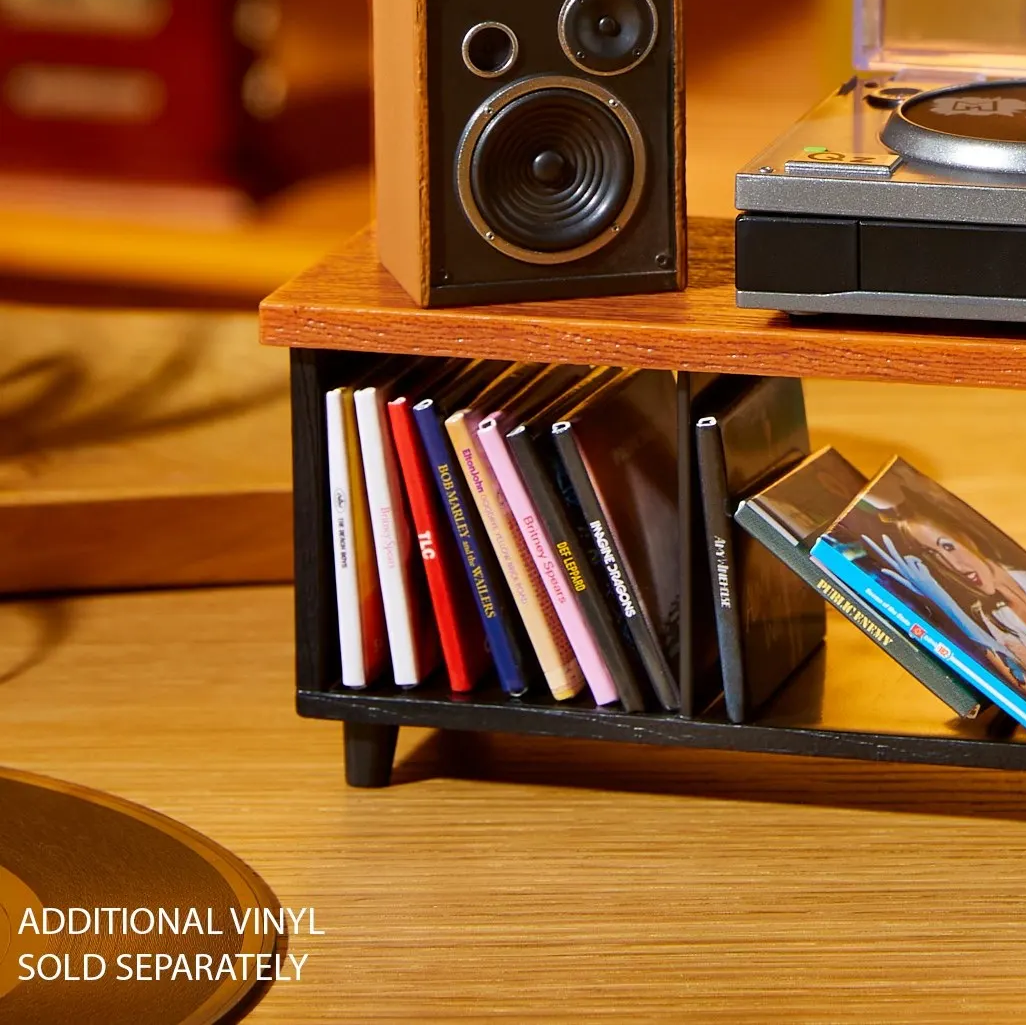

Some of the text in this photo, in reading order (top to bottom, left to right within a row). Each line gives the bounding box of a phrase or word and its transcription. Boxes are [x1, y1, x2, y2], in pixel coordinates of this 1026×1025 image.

[418, 530, 436, 560] TLC
[438, 464, 454, 490] BOB
[447, 490, 470, 538] MARLEY
[472, 566, 496, 619] WAILERS
[523, 515, 566, 604] Britney Spears
[557, 541, 586, 592] DEF LEPPARD
[590, 520, 637, 618] IMAGINE DRAGONS
[816, 579, 893, 647] PUBLIC ENEMY
